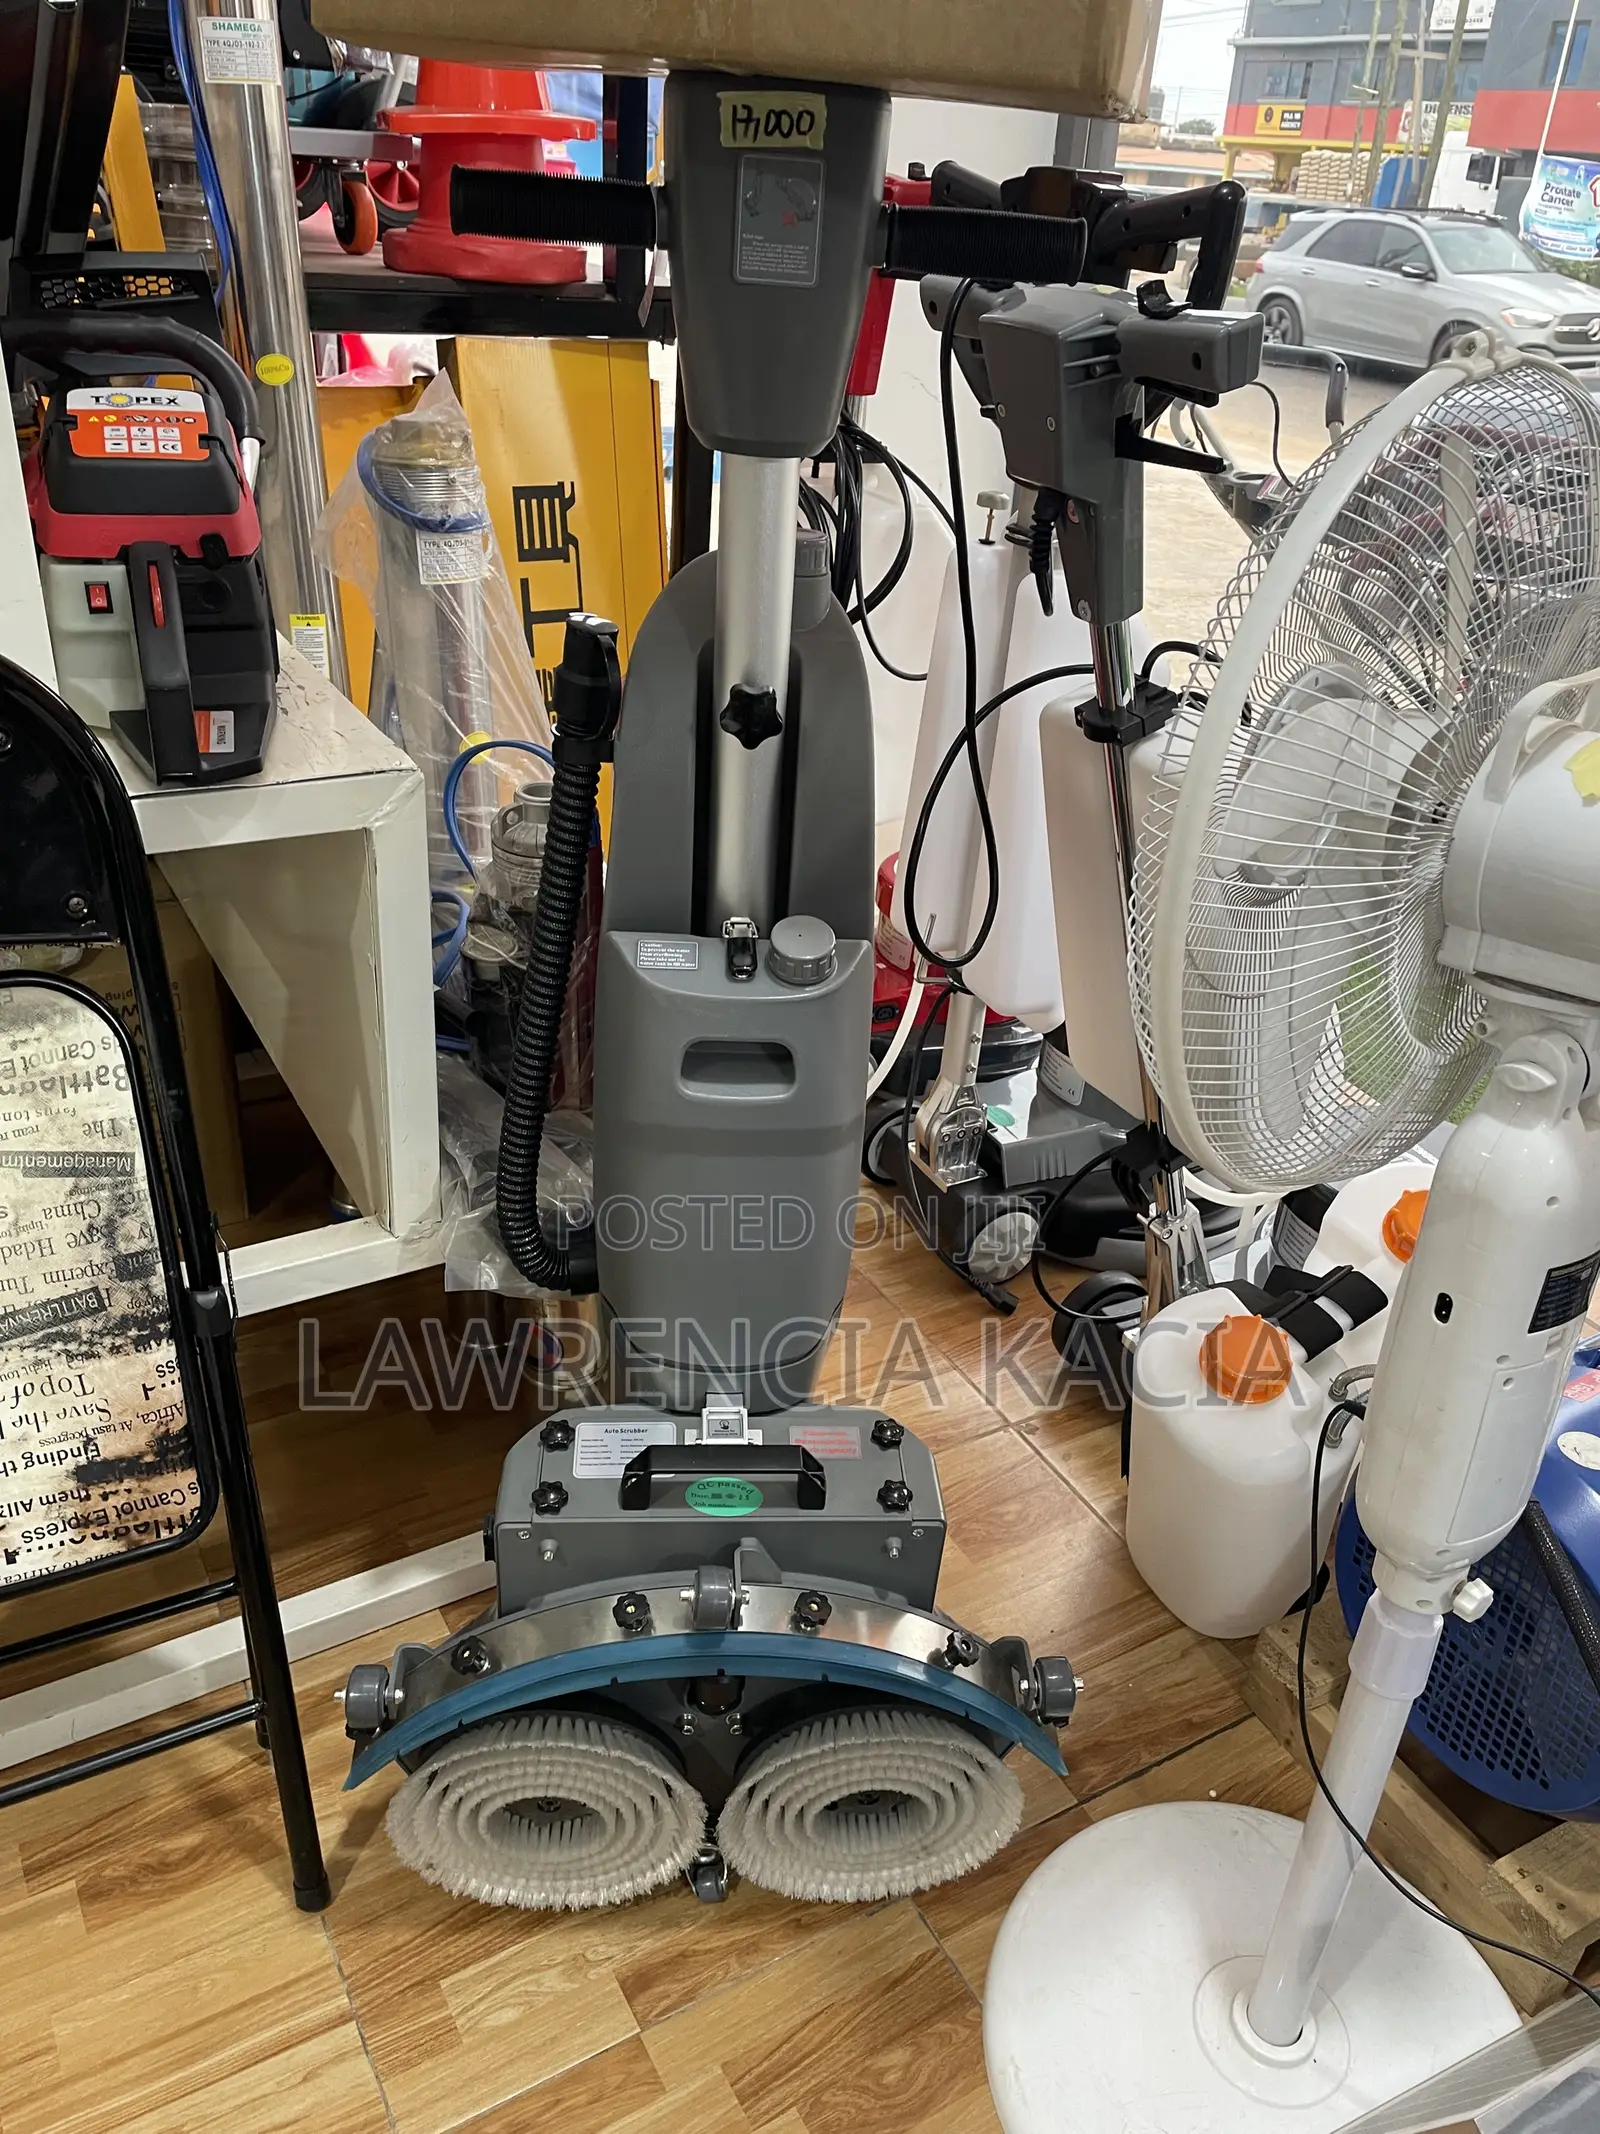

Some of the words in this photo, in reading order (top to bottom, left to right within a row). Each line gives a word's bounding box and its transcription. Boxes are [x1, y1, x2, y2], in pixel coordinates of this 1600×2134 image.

[212, 22, 263, 32] SHAMEGA
[1544, 182, 1581, 199] Prostate
[90, 393, 181, 407] TOPEX
[82, 1118, 122, 1139] The
[0, 1154, 131, 1171] Managementm
[40, 1373, 94, 1397] Top
[10, 1382, 35, 1409] of
[56, 1398, 112, 1422] Save
[119, 1420, 133, 1431] At
[697, 1481, 714, 1490] QC
[718, 1481, 755, 1495] passed
[112, 1488, 186, 1518] Cannot
[21, 1508, 110, 1544] Express
